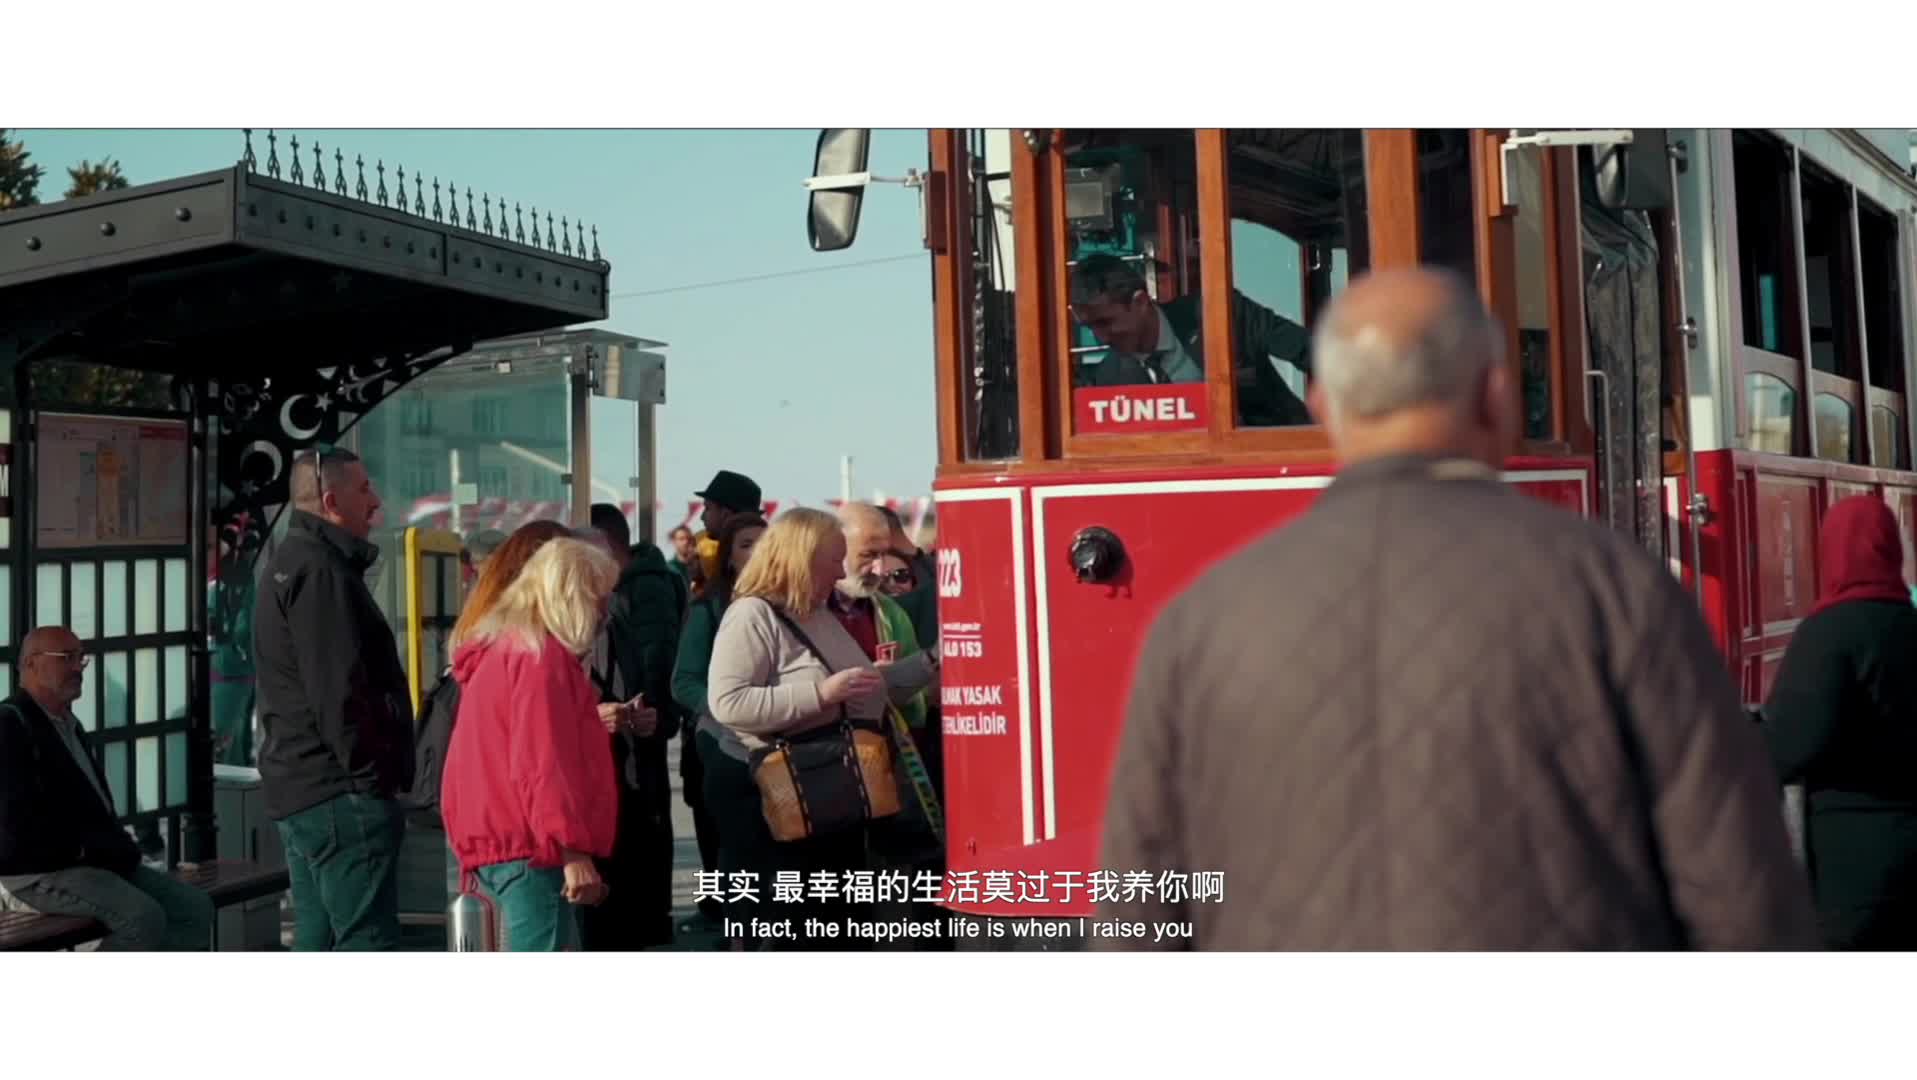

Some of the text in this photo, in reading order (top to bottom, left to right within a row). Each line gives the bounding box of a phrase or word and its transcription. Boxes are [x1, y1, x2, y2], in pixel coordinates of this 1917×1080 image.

[1088, 395, 1196, 423] TÜNEL
[960, 640, 983, 658] 153
[962, 685, 1002, 704] YASAK
